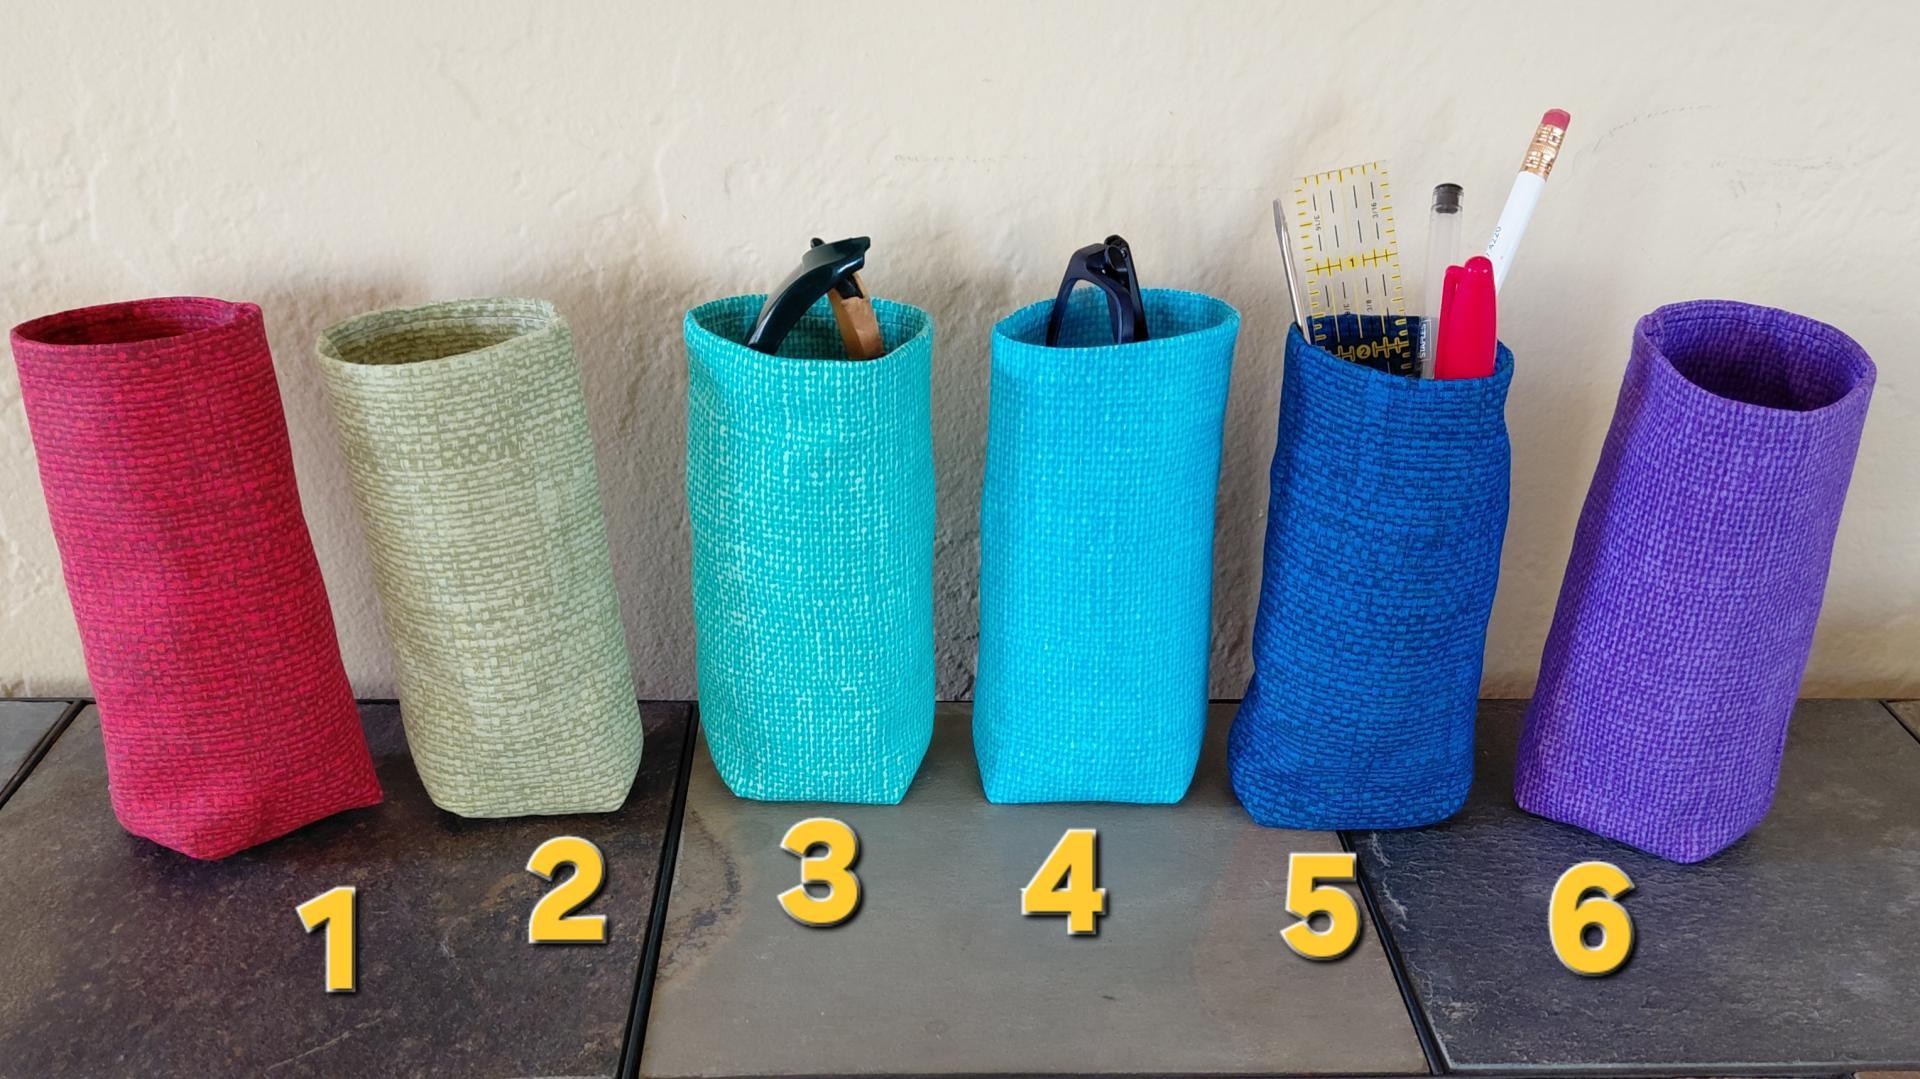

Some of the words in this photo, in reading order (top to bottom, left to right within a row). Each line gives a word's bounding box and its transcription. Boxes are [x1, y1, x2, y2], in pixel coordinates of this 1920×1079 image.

[1314, 215, 1322, 231] 3/16
[1420, 322, 1428, 358] STAPLES
[1360, 346, 1368, 357] 2
